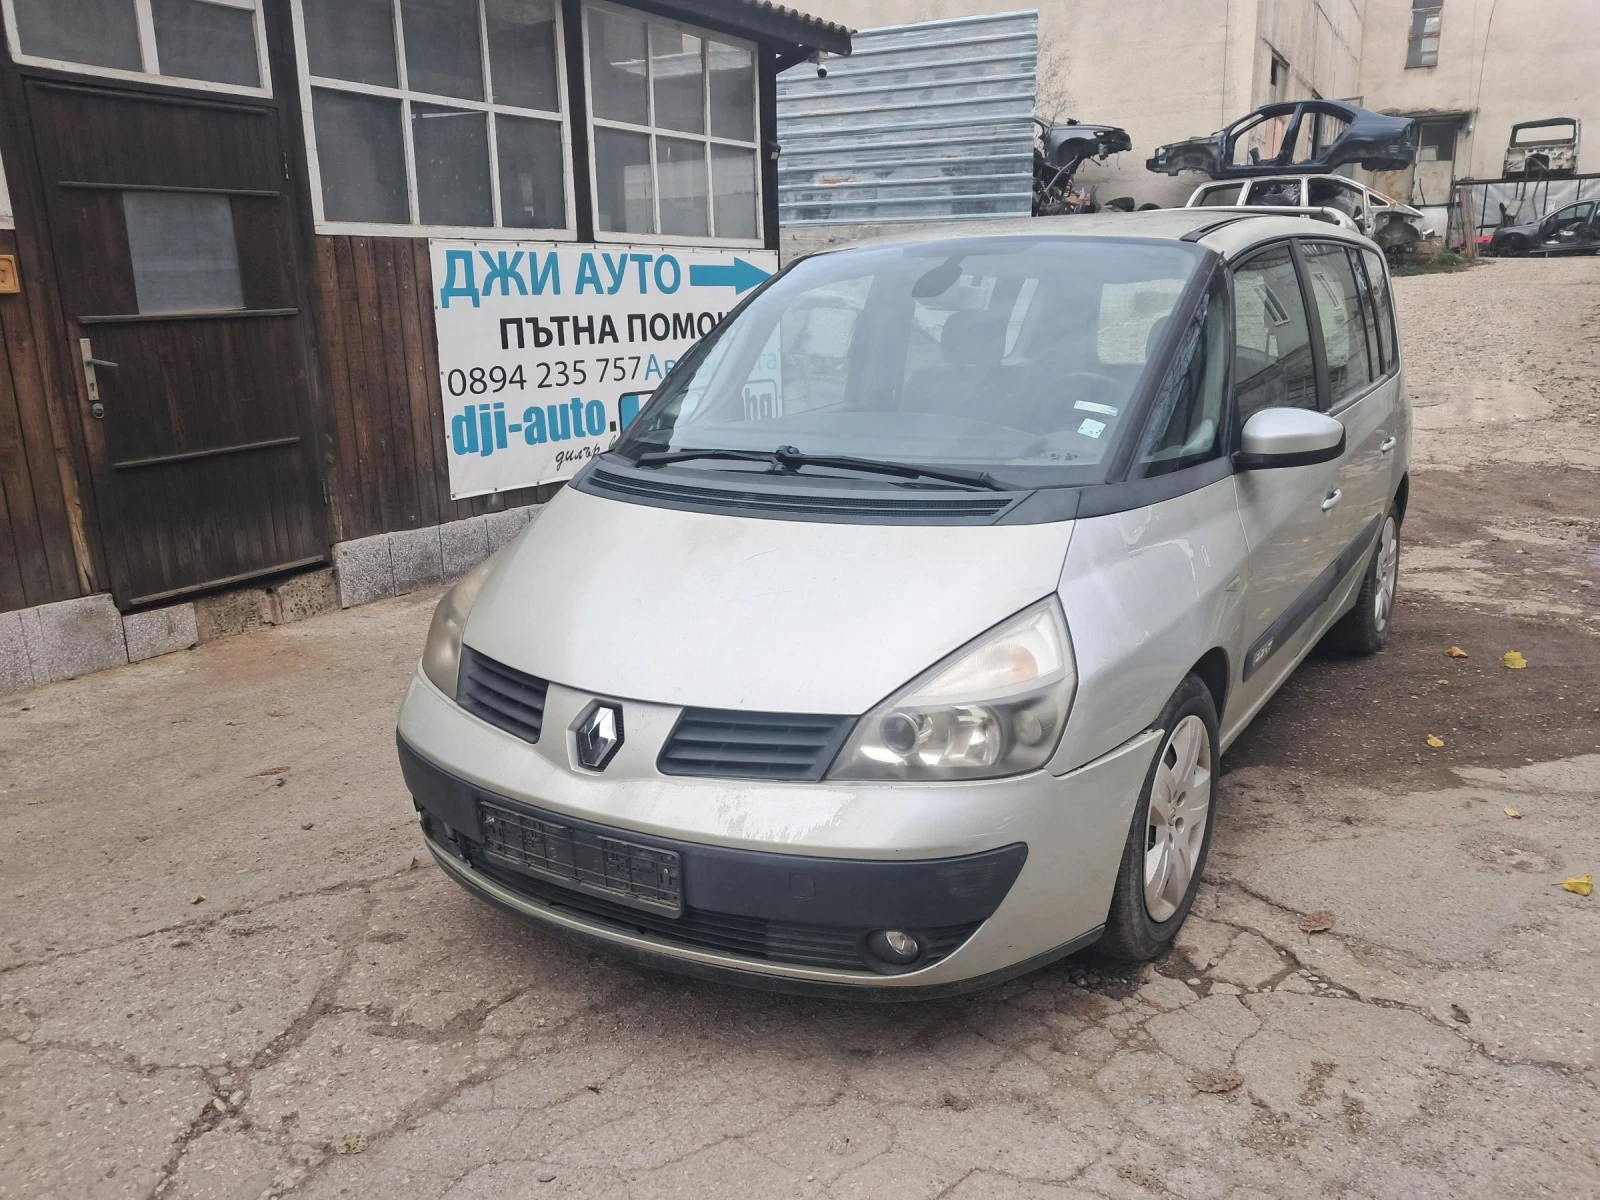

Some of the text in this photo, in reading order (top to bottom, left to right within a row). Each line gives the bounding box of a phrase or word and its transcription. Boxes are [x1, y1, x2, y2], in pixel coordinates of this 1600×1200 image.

[440, 249, 682, 310] ДЖИ АУТО
[499, 315, 619, 350] ПЪТНА
[447, 355, 642, 397] 0894 235 757
[555, 442, 601, 472] дилър
